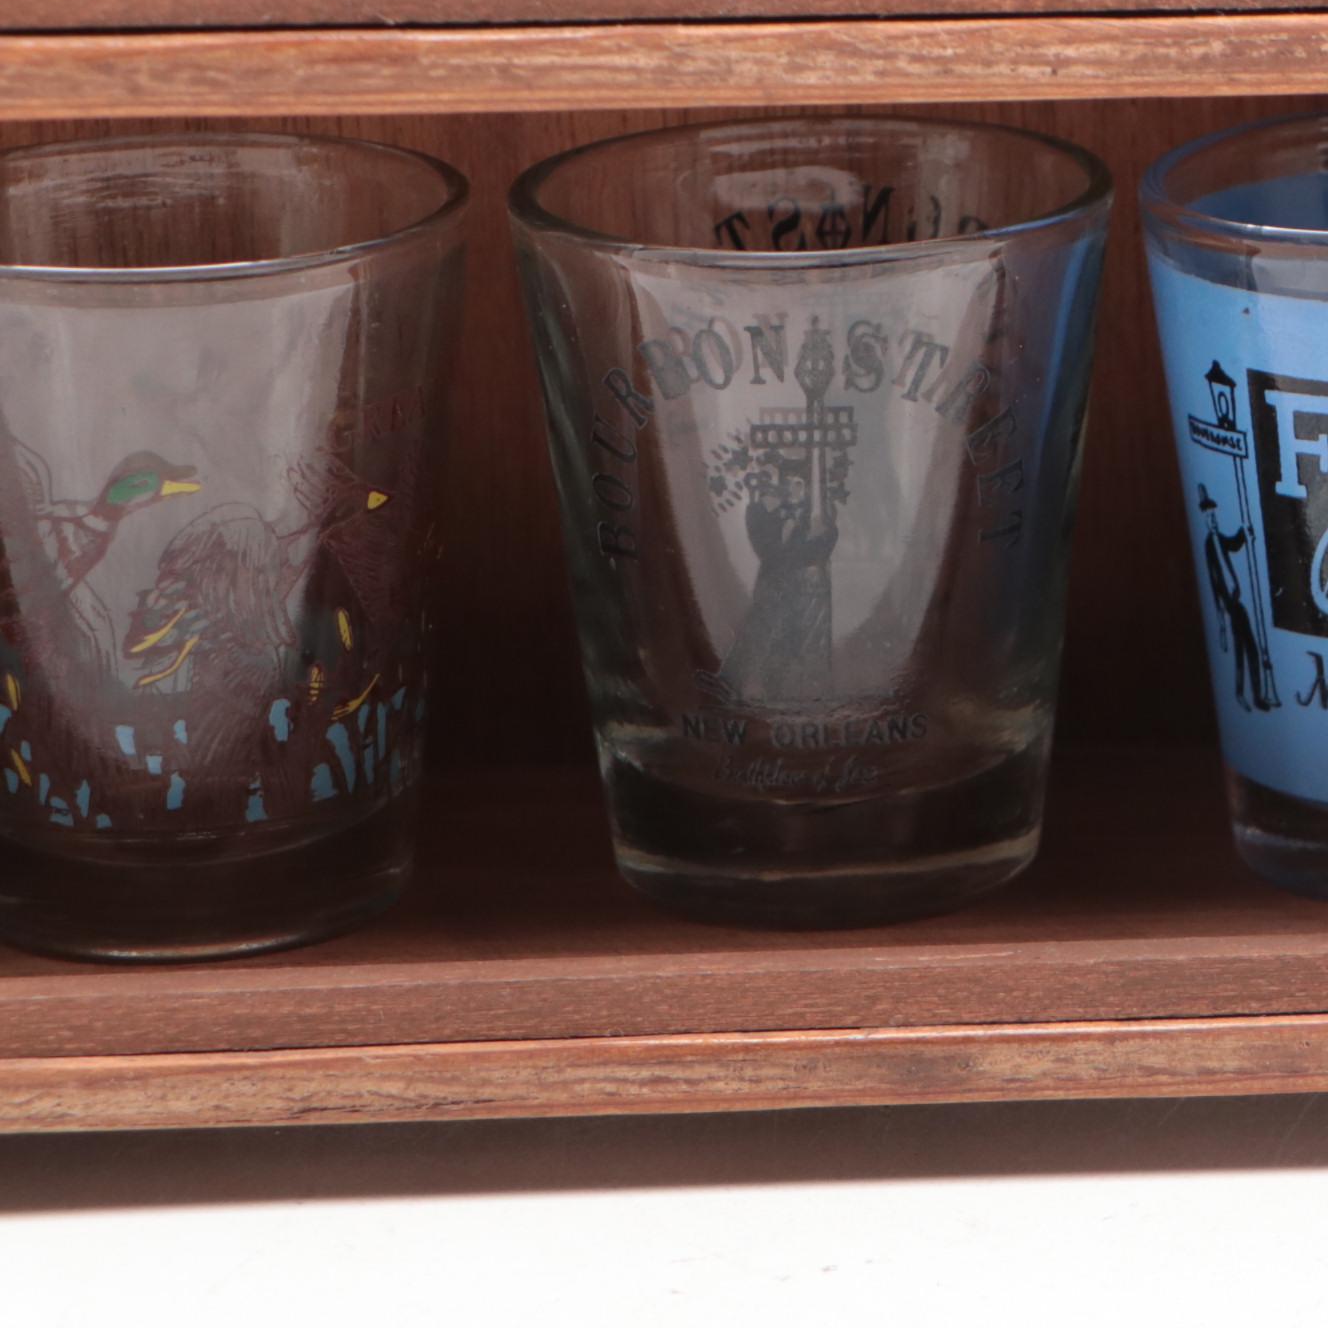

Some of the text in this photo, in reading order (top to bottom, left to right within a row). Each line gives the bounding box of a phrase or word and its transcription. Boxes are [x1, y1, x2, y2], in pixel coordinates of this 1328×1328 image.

[592, 320, 1025, 560] BOURBON STREET
[680, 712, 929, 748] NEW ORLEANS
